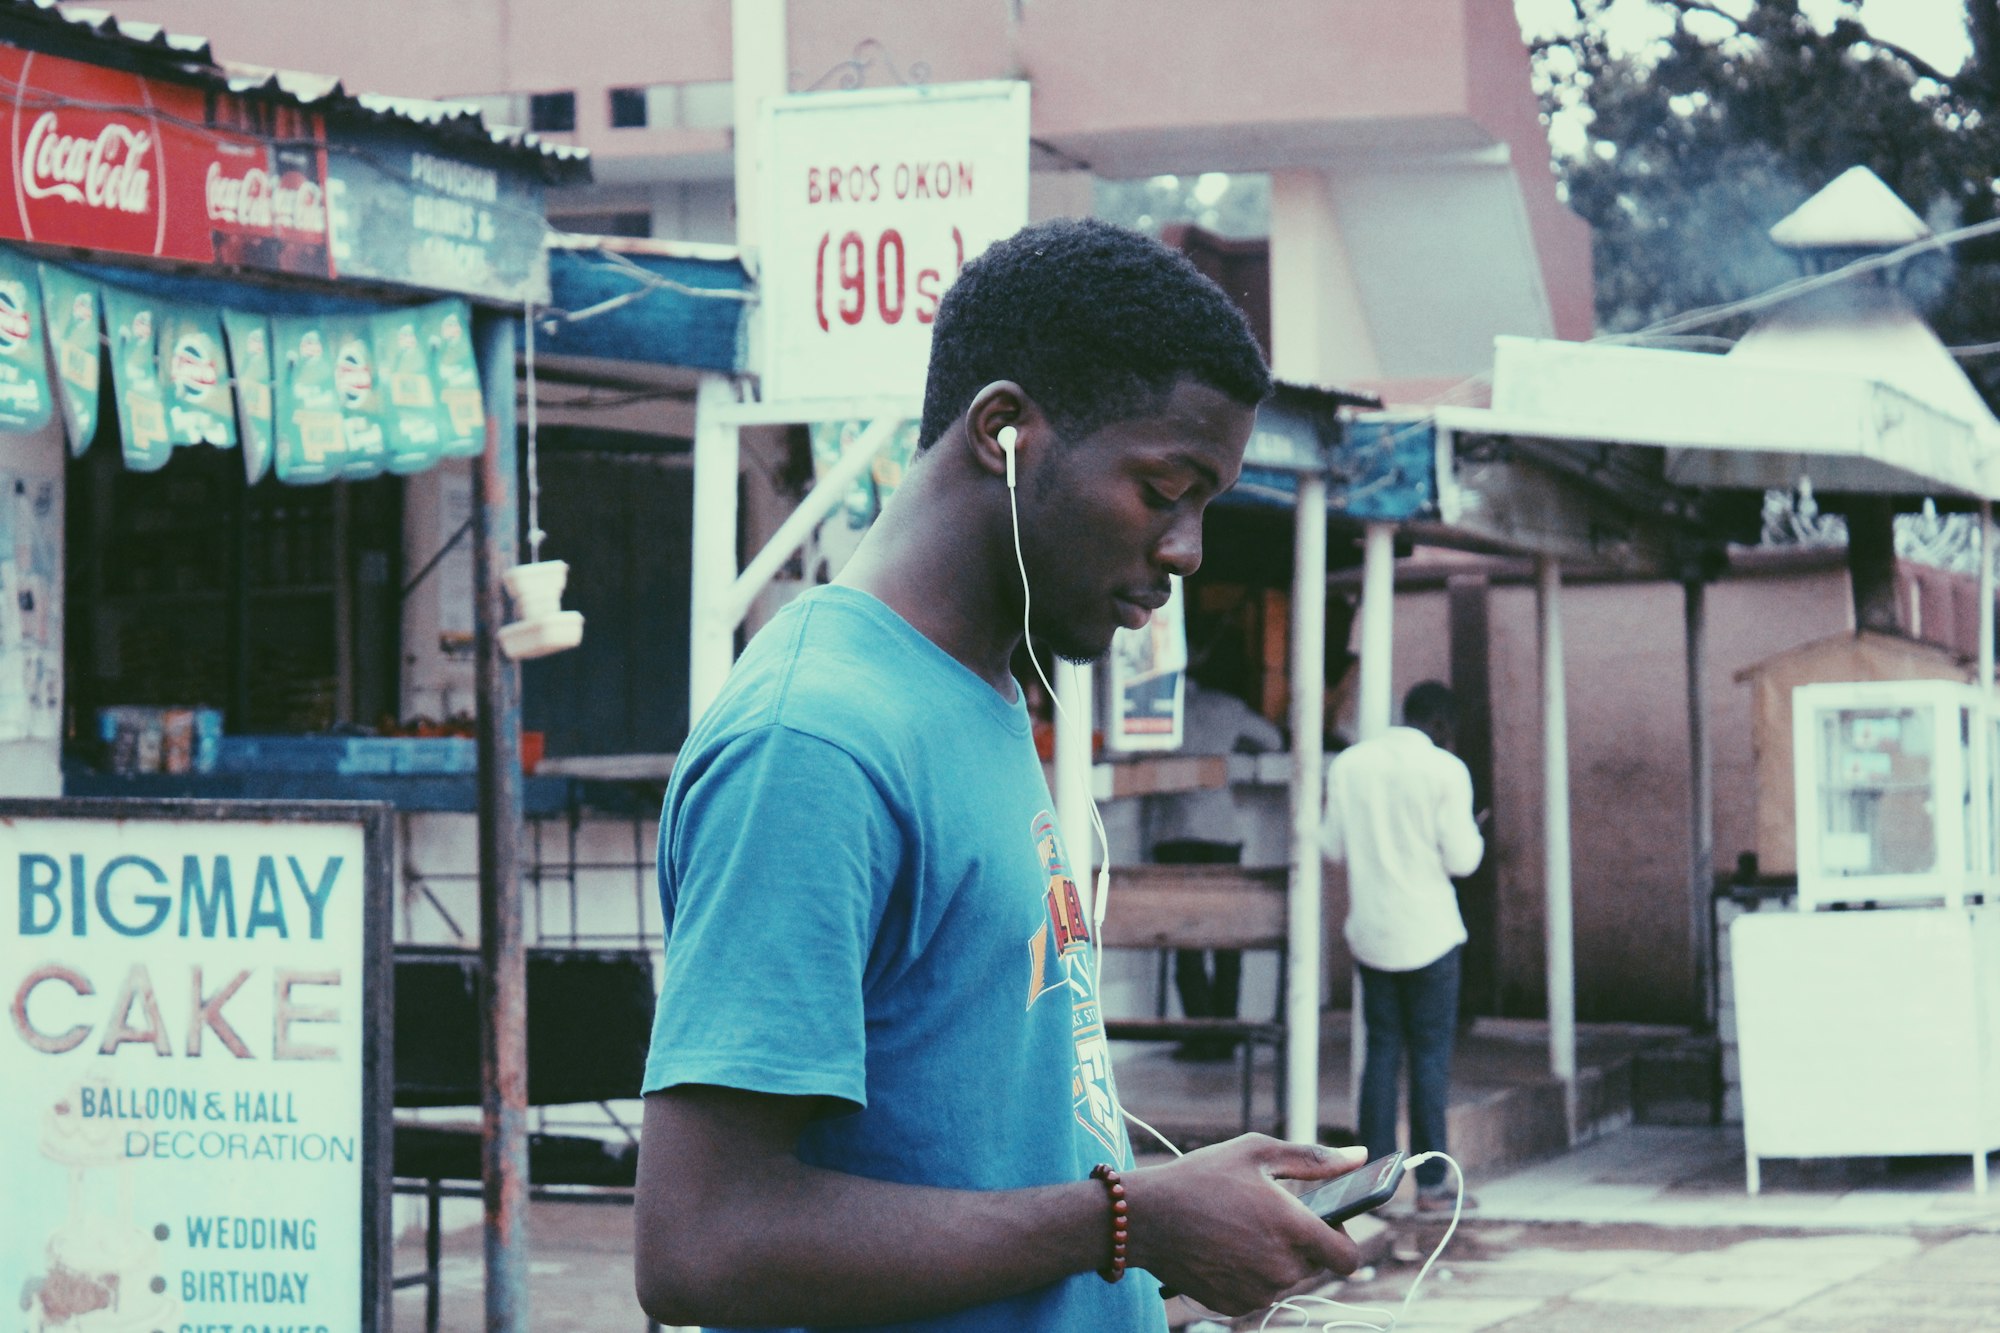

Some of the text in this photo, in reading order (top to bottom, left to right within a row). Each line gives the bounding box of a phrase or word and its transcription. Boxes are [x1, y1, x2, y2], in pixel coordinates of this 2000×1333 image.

[808, 162, 973, 204] BROS OKON
[18, 853, 345, 940] BIGMAY
[9, 964, 342, 1061] CAKE
[80, 1086, 298, 1123] BALLOON & HALL
[124, 1131, 355, 1163] DECORATION
[186, 1216, 317, 1251] WEDDING
[181, 1271, 309, 1304] BIRTHDAY
